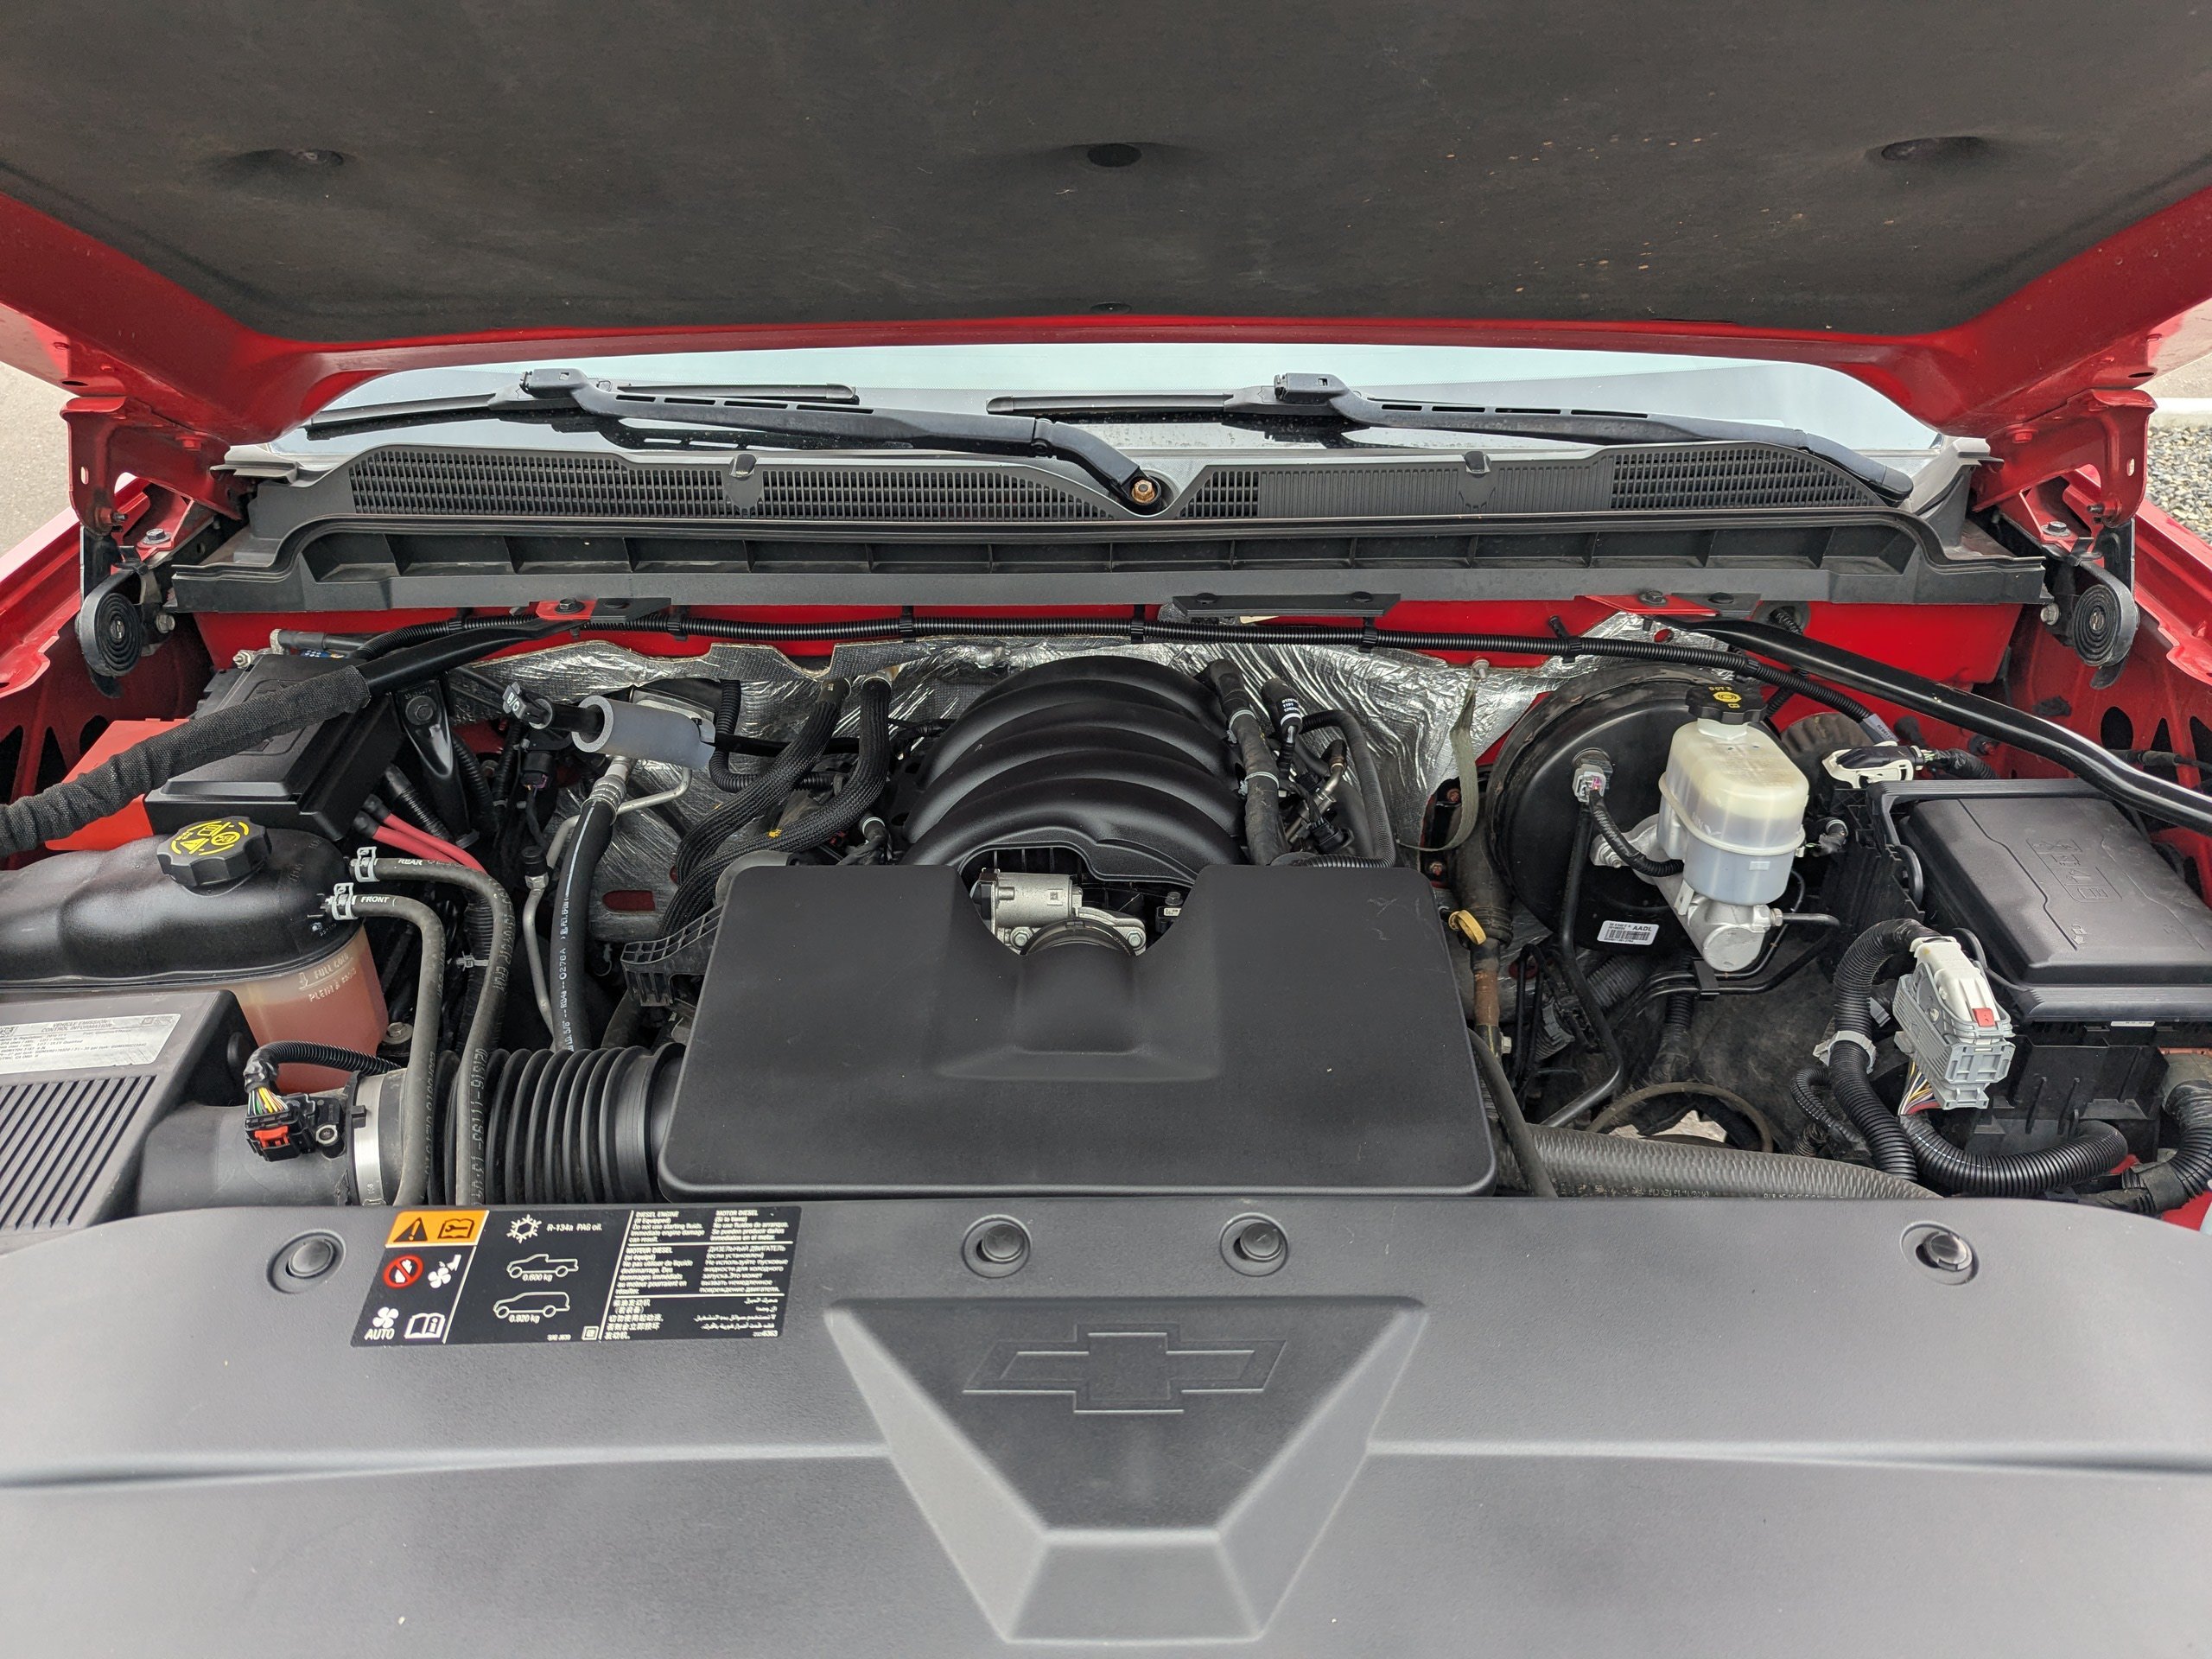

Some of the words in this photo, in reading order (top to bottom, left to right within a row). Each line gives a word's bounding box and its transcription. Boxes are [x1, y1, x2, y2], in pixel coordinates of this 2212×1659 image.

[543, 1274, 553, 1282] kg
[509, 1314, 530, 1323] 0.920
[531, 1314, 540, 1324] kg
[364, 1328, 395, 1340] AUTO
